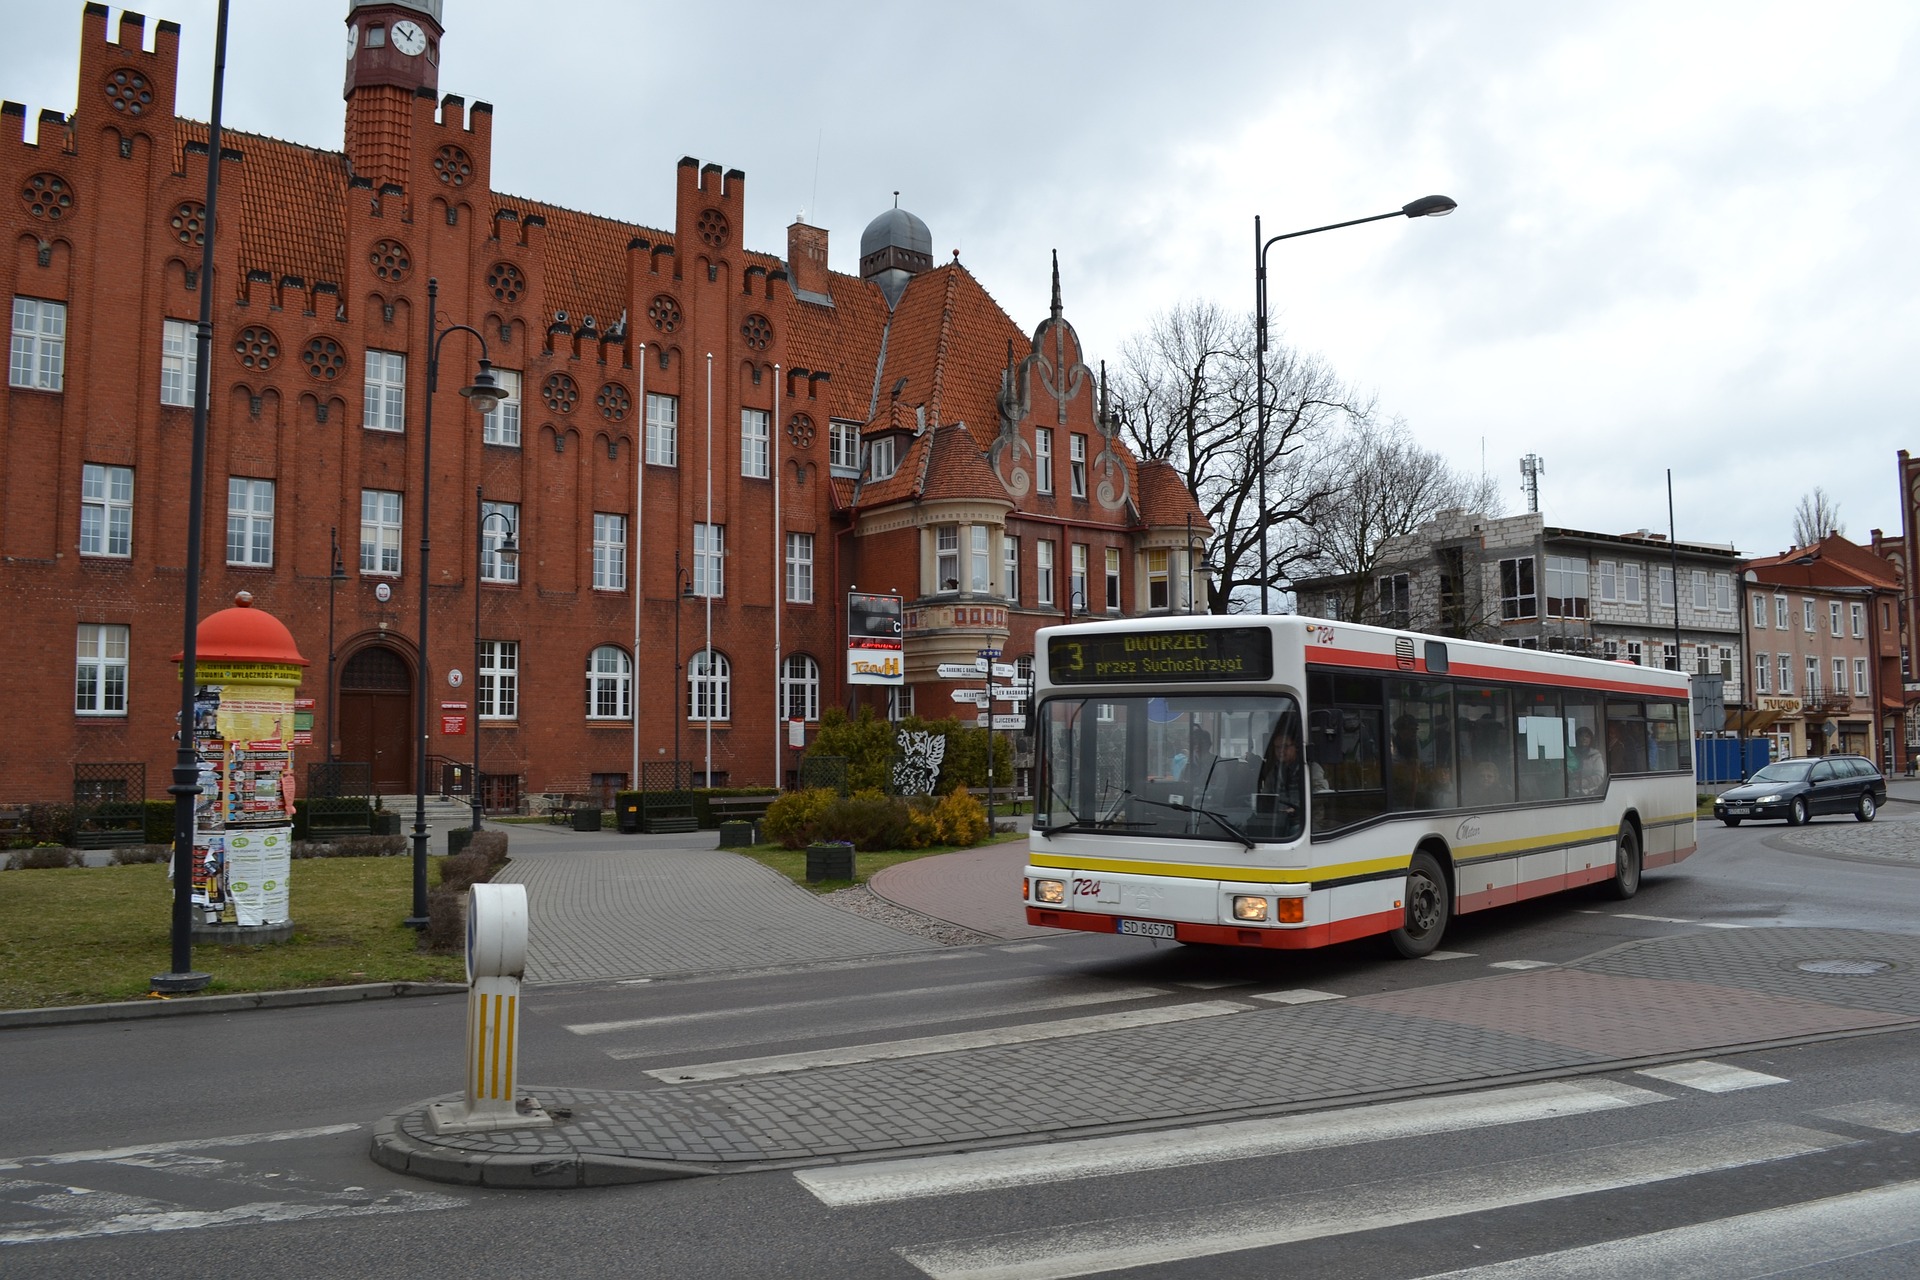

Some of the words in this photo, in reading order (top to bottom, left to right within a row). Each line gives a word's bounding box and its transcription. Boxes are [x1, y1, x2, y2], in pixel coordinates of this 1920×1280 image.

[1124, 633, 1209, 653] DWORZEC
[1317, 625, 1335, 645] 724
[1067, 643, 1084, 671] 3
[1095, 660, 1137, 676] przez
[1142, 655, 1243, 673] Suchostrzygi
[1073, 878, 1101, 897] 724
[1122, 884, 1165, 899] MAN
[1123, 920, 1139, 934] SD
[1140, 922, 1174, 938] 86570
